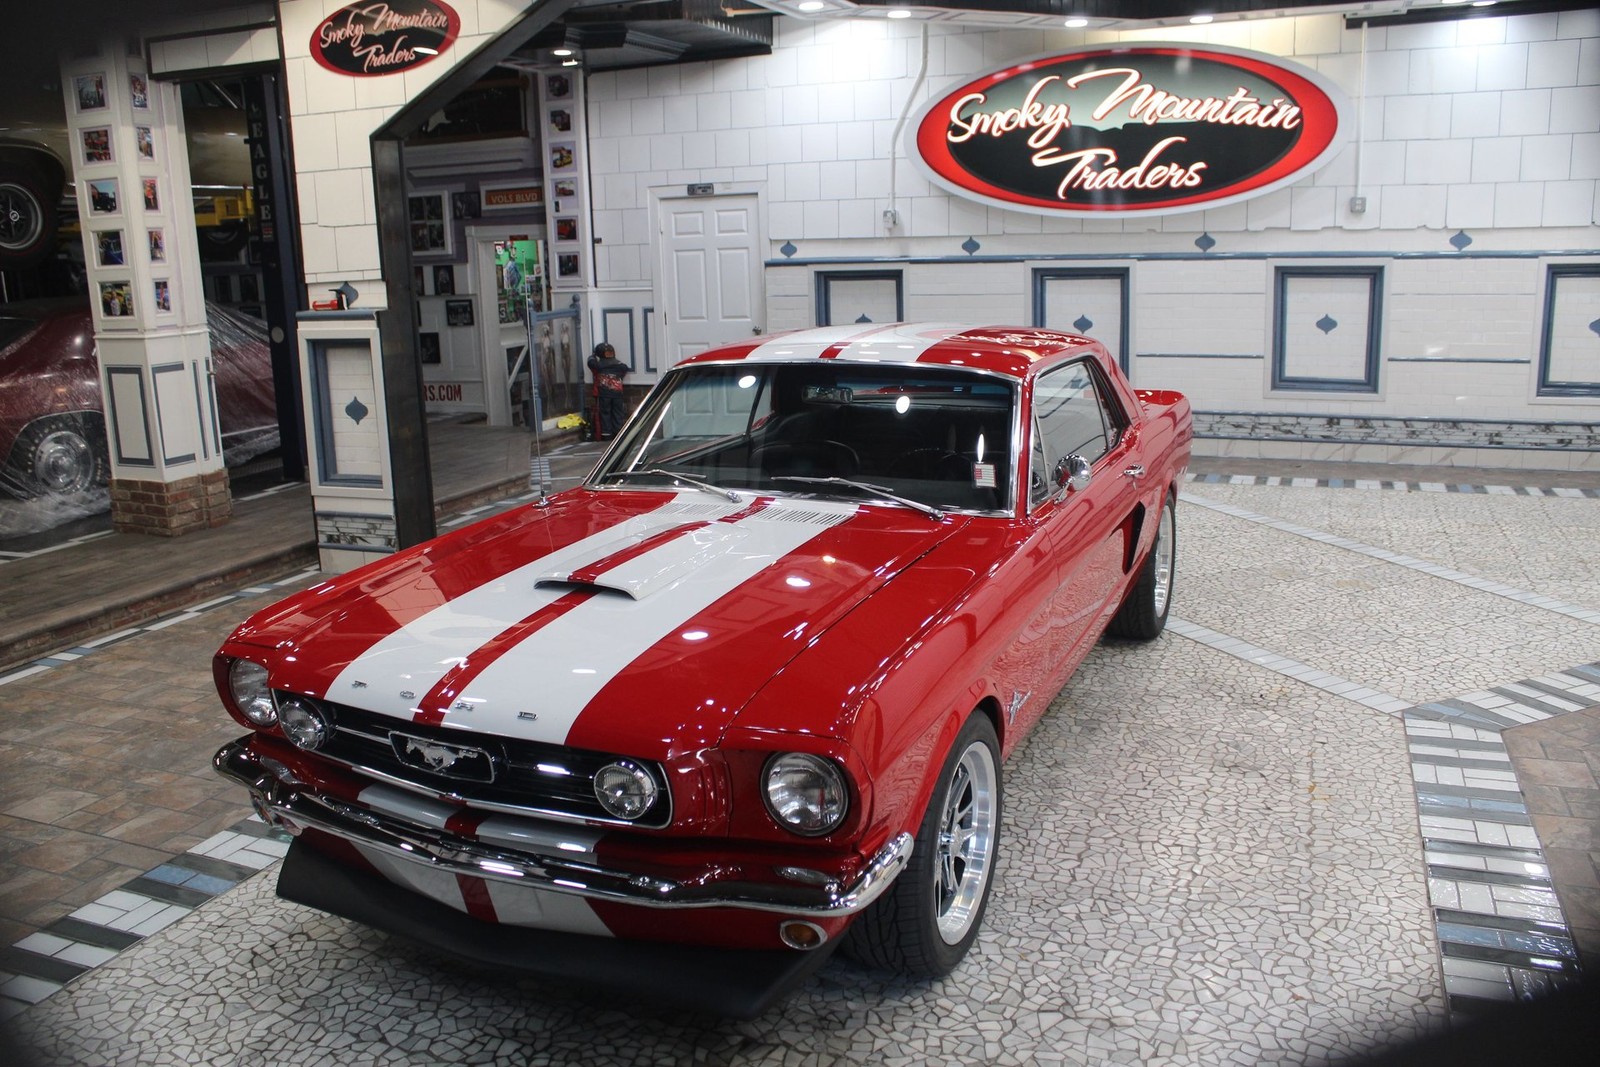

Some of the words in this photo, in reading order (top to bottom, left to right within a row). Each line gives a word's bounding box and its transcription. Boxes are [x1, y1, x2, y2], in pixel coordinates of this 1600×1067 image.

[320, 9, 365, 48] Smoky
[363, 3, 448, 31] Mountain
[353, 35, 416, 73] Traders
[947, 75, 1070, 149] Smoky
[1067, 67, 1302, 130] Mountain
[1032, 136, 1207, 200] Traders
[490, 194, 514, 205] VOLS
[515, 192, 538, 204] BLVD
